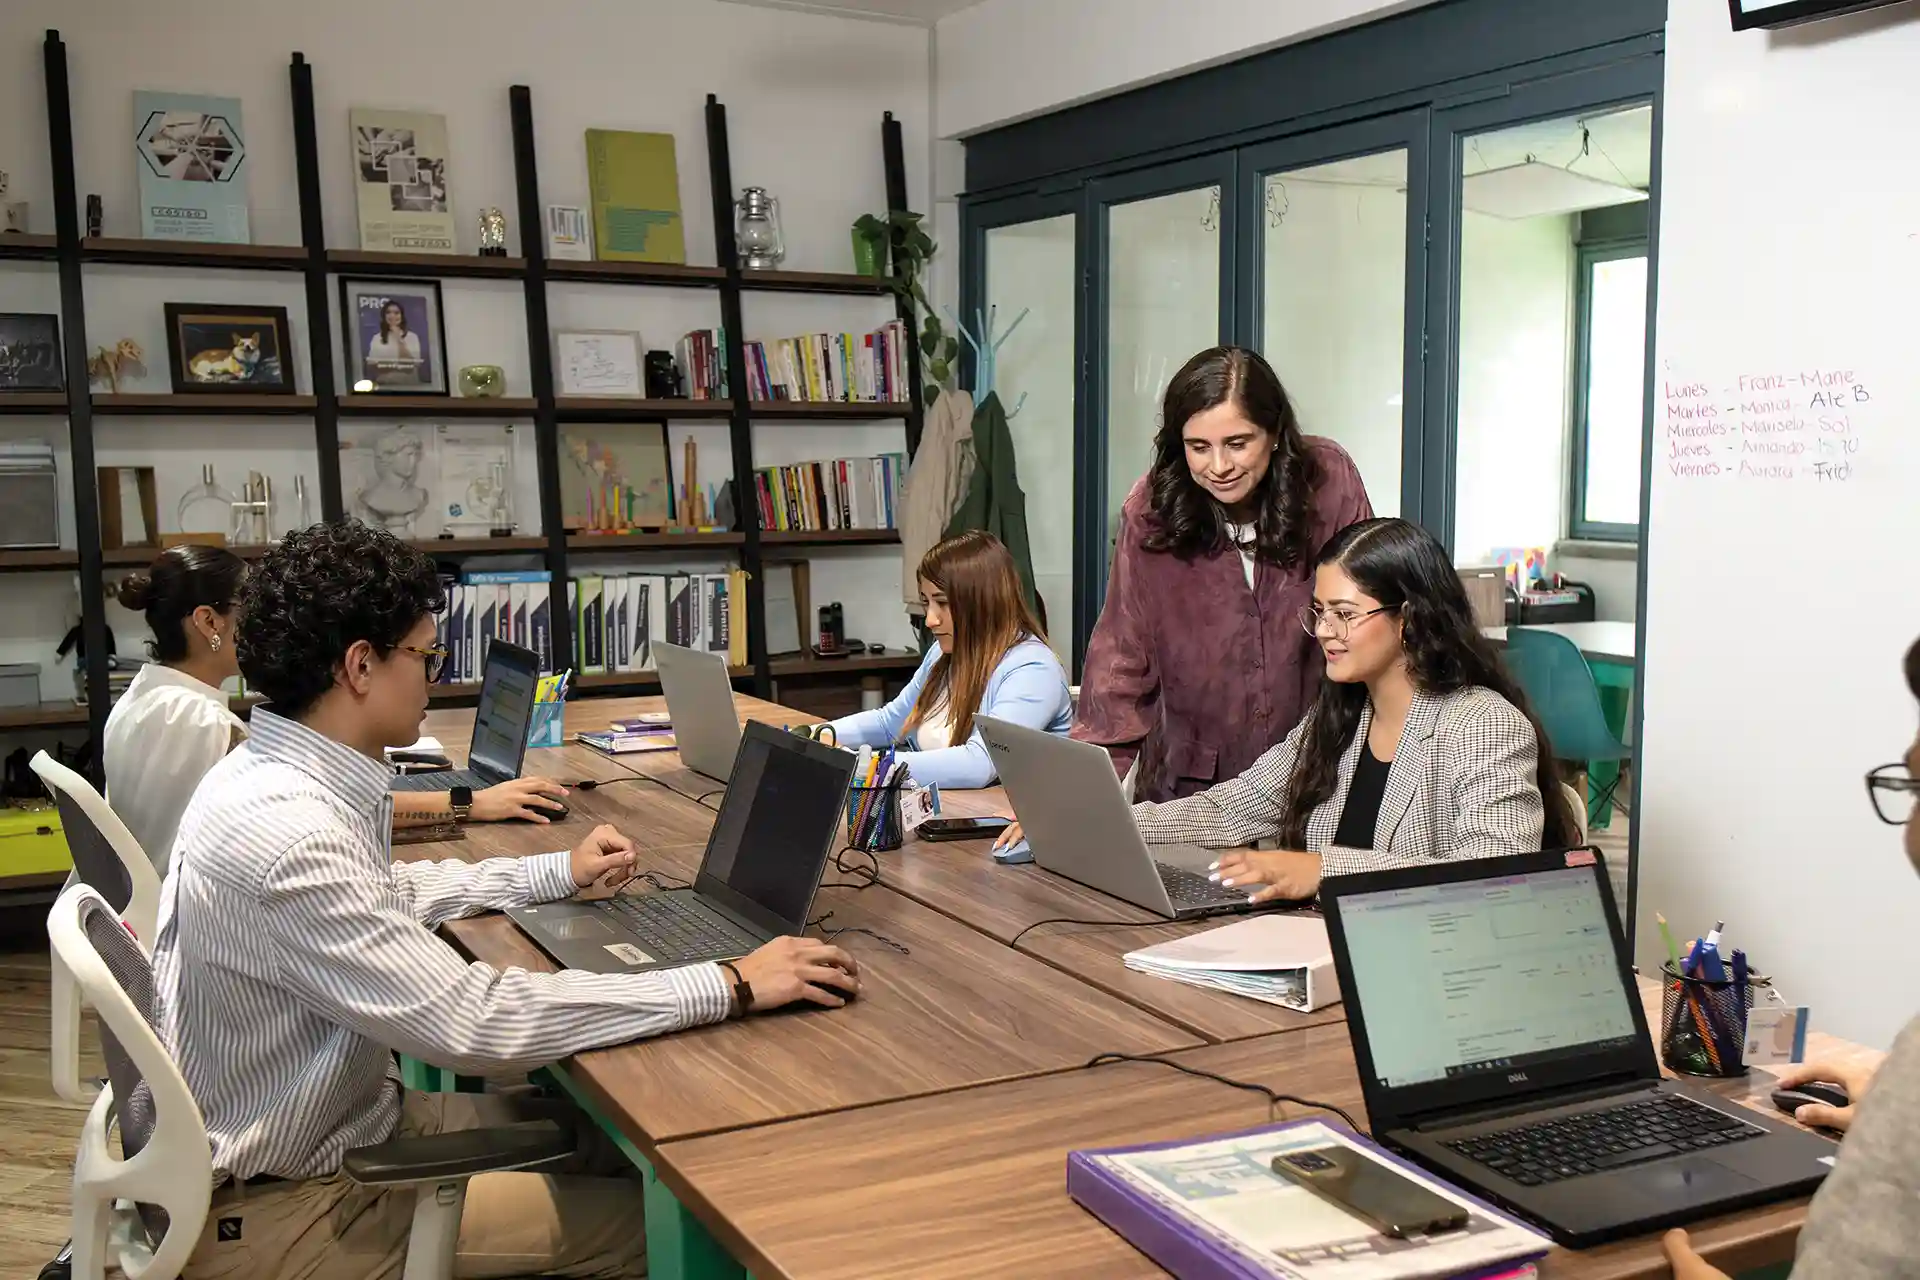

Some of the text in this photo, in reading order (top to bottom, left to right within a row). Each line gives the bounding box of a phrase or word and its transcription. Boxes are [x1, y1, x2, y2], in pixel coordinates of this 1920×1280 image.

[1665, 381, 1708, 399] Lunes
[1738, 375, 1786, 393] Franz
[1667, 403, 1718, 420] Martes
[1810, 391, 1846, 409] Ale
[1667, 418, 1727, 438] Miercoles
[1669, 441, 1711, 459] Jueves
[1669, 460, 1721, 477] Viernes
